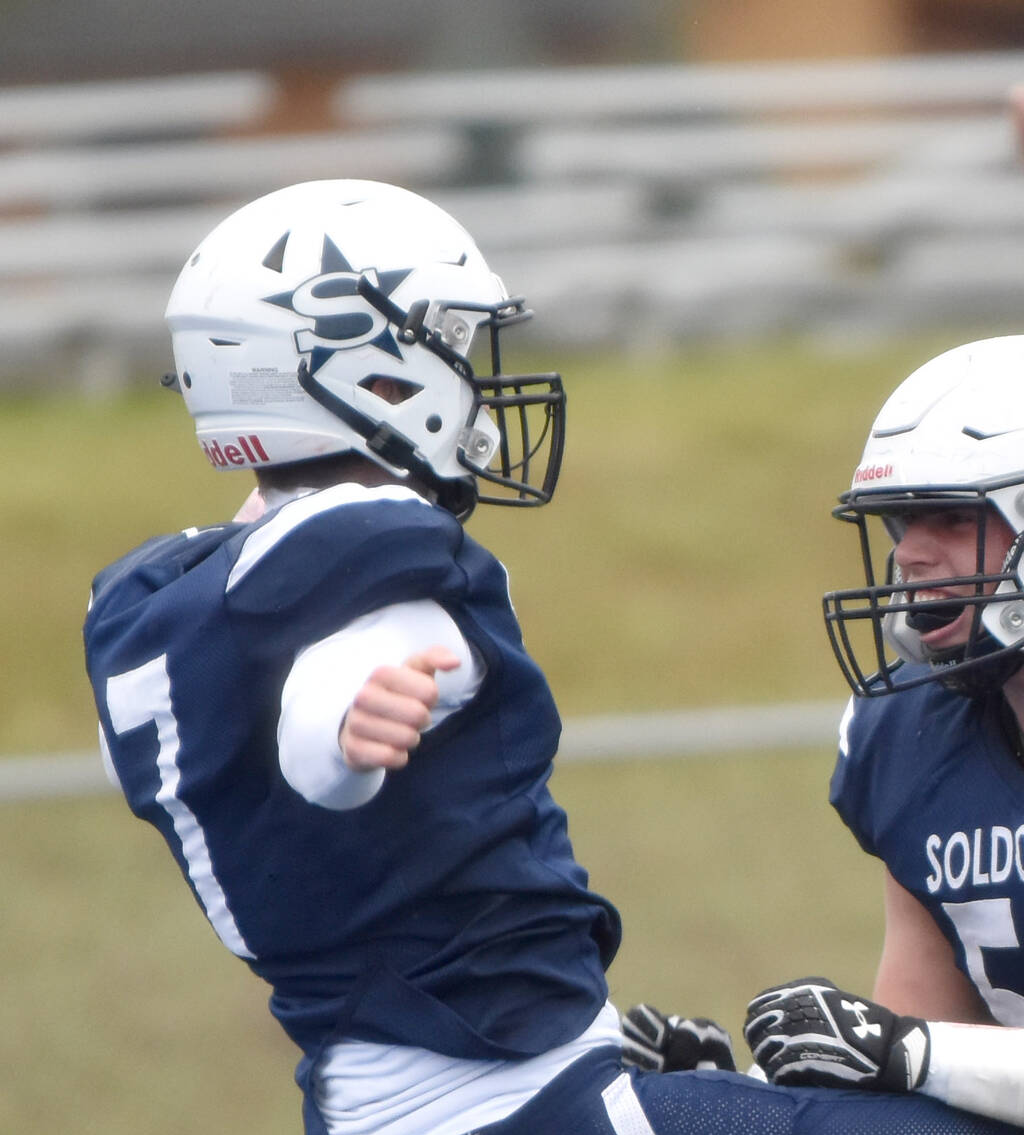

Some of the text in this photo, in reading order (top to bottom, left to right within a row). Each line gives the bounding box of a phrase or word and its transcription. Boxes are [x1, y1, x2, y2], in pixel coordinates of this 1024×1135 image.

[292, 267, 389, 354] S
[855, 464, 893, 483] Riddell
[106, 652, 258, 960] 7
